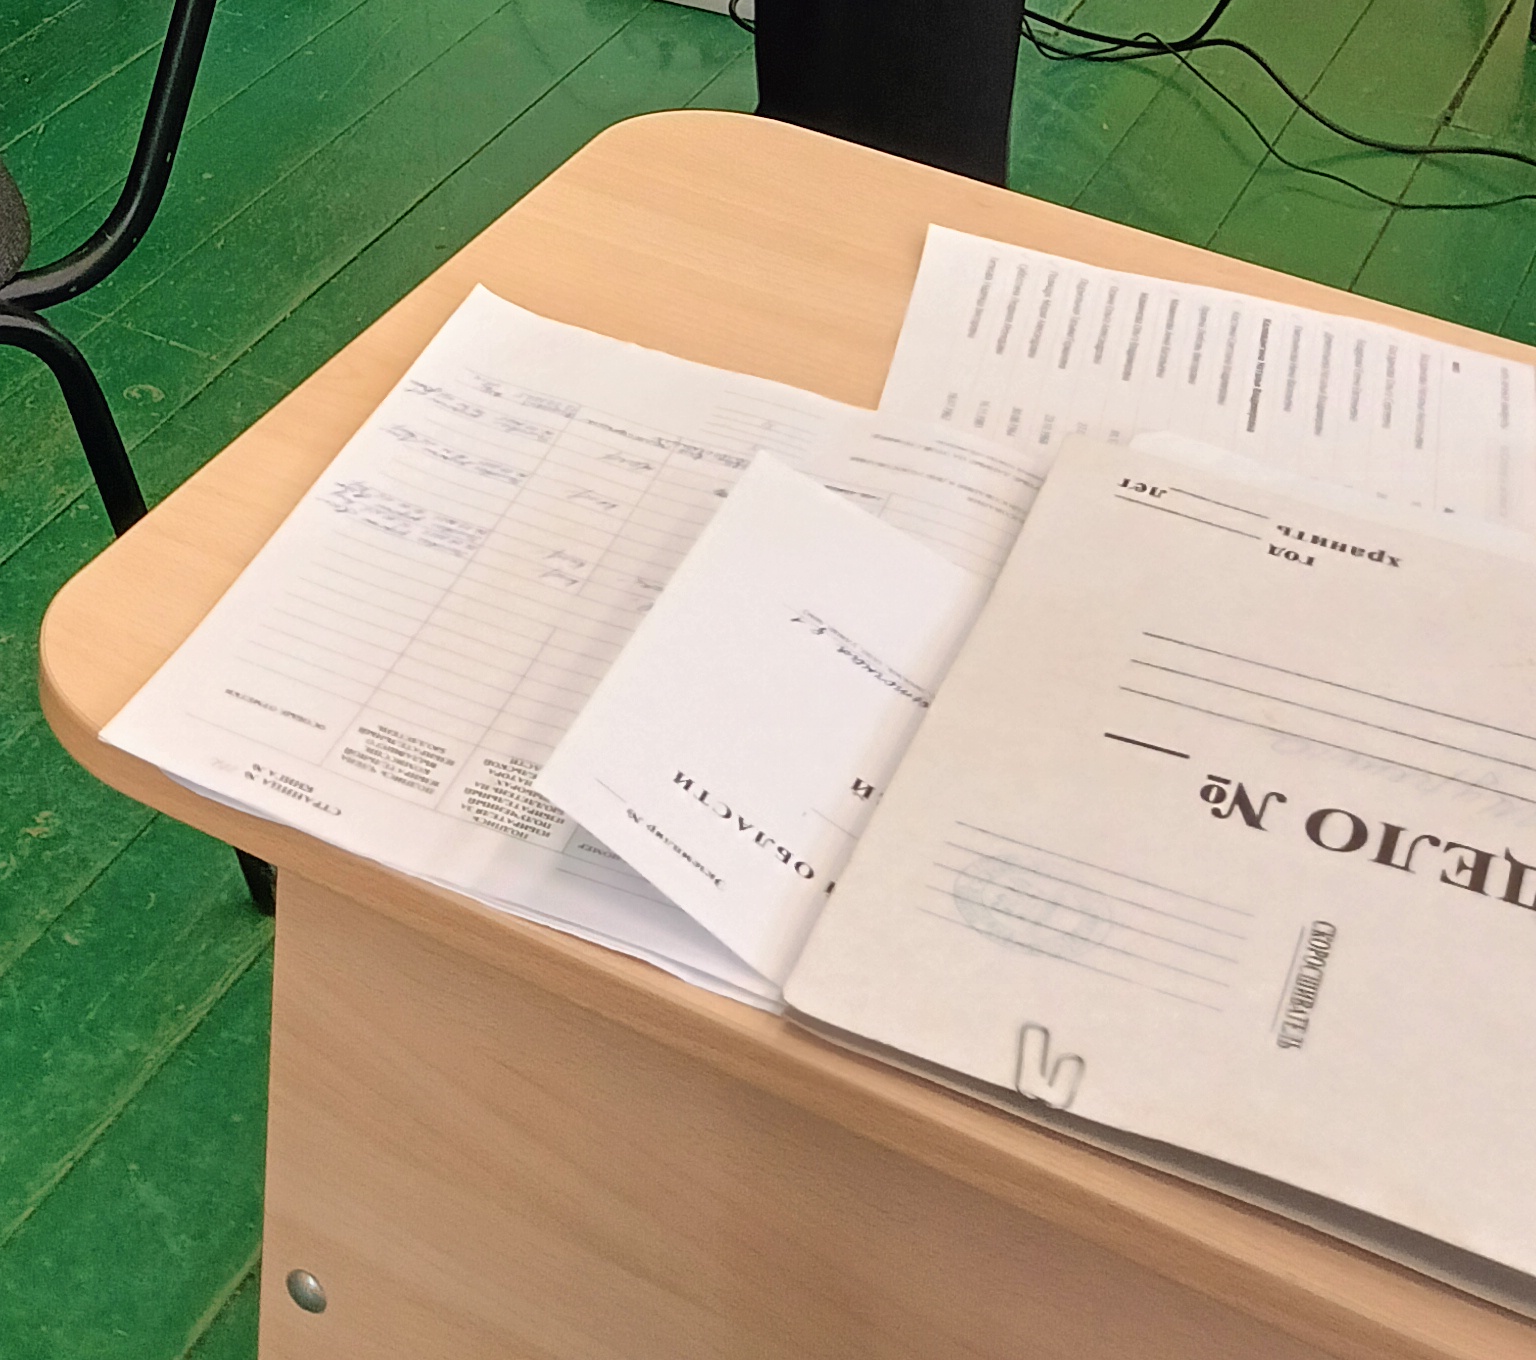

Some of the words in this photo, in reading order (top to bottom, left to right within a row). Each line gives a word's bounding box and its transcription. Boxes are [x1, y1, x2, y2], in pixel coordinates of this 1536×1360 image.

[1117, 478, 1168, 498] лет
[1267, 543, 1315, 567] год
[1277, 525, 1402, 568] хранить
[263, 779, 341, 816] СТРАНИЦА
[627, 809, 641, 823] №
[1199, 774, 1288, 832] №
[473, 816, 529, 840] ПОДПИСЬ
[674, 770, 816, 880] ОБЛАСТИ
[647, 825, 722, 886] Экземпляр
[1276, 920, 1337, 1049] СКОРОСШИВАТЕЛЬ
